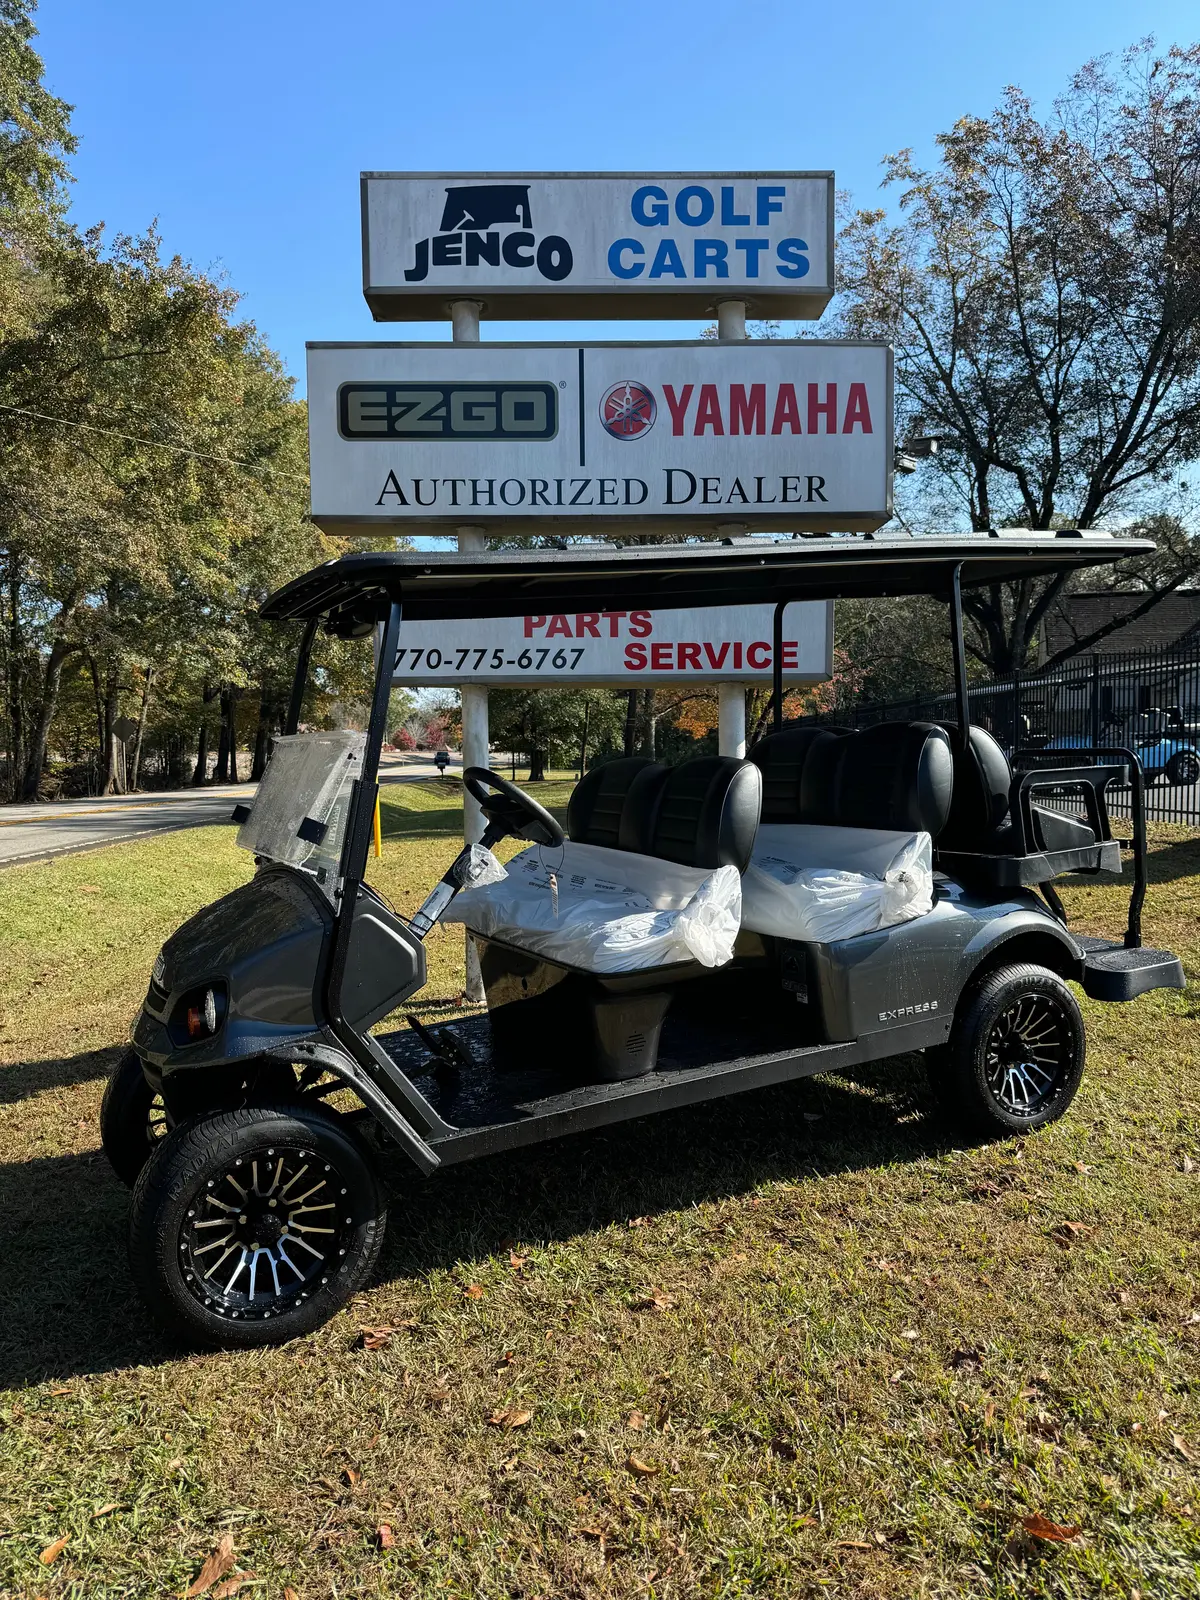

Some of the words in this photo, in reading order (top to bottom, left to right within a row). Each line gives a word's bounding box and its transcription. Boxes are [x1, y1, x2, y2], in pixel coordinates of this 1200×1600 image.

[630, 185, 786, 226] GOLF
[404, 231, 573, 281] JENCO
[607, 238, 811, 279] CARTS
[347, 390, 547, 432] EZGO
[662, 383, 873, 436] YAMAHA
[374, 468, 649, 506] AUTHORIZED
[662, 468, 829, 505] DEALER
[523, 611, 653, 638] PARTS
[394, 648, 585, 671] 770-775-6767
[623, 641, 799, 671] SERVICE
[878, 1000, 938, 1022] EXPRESS
